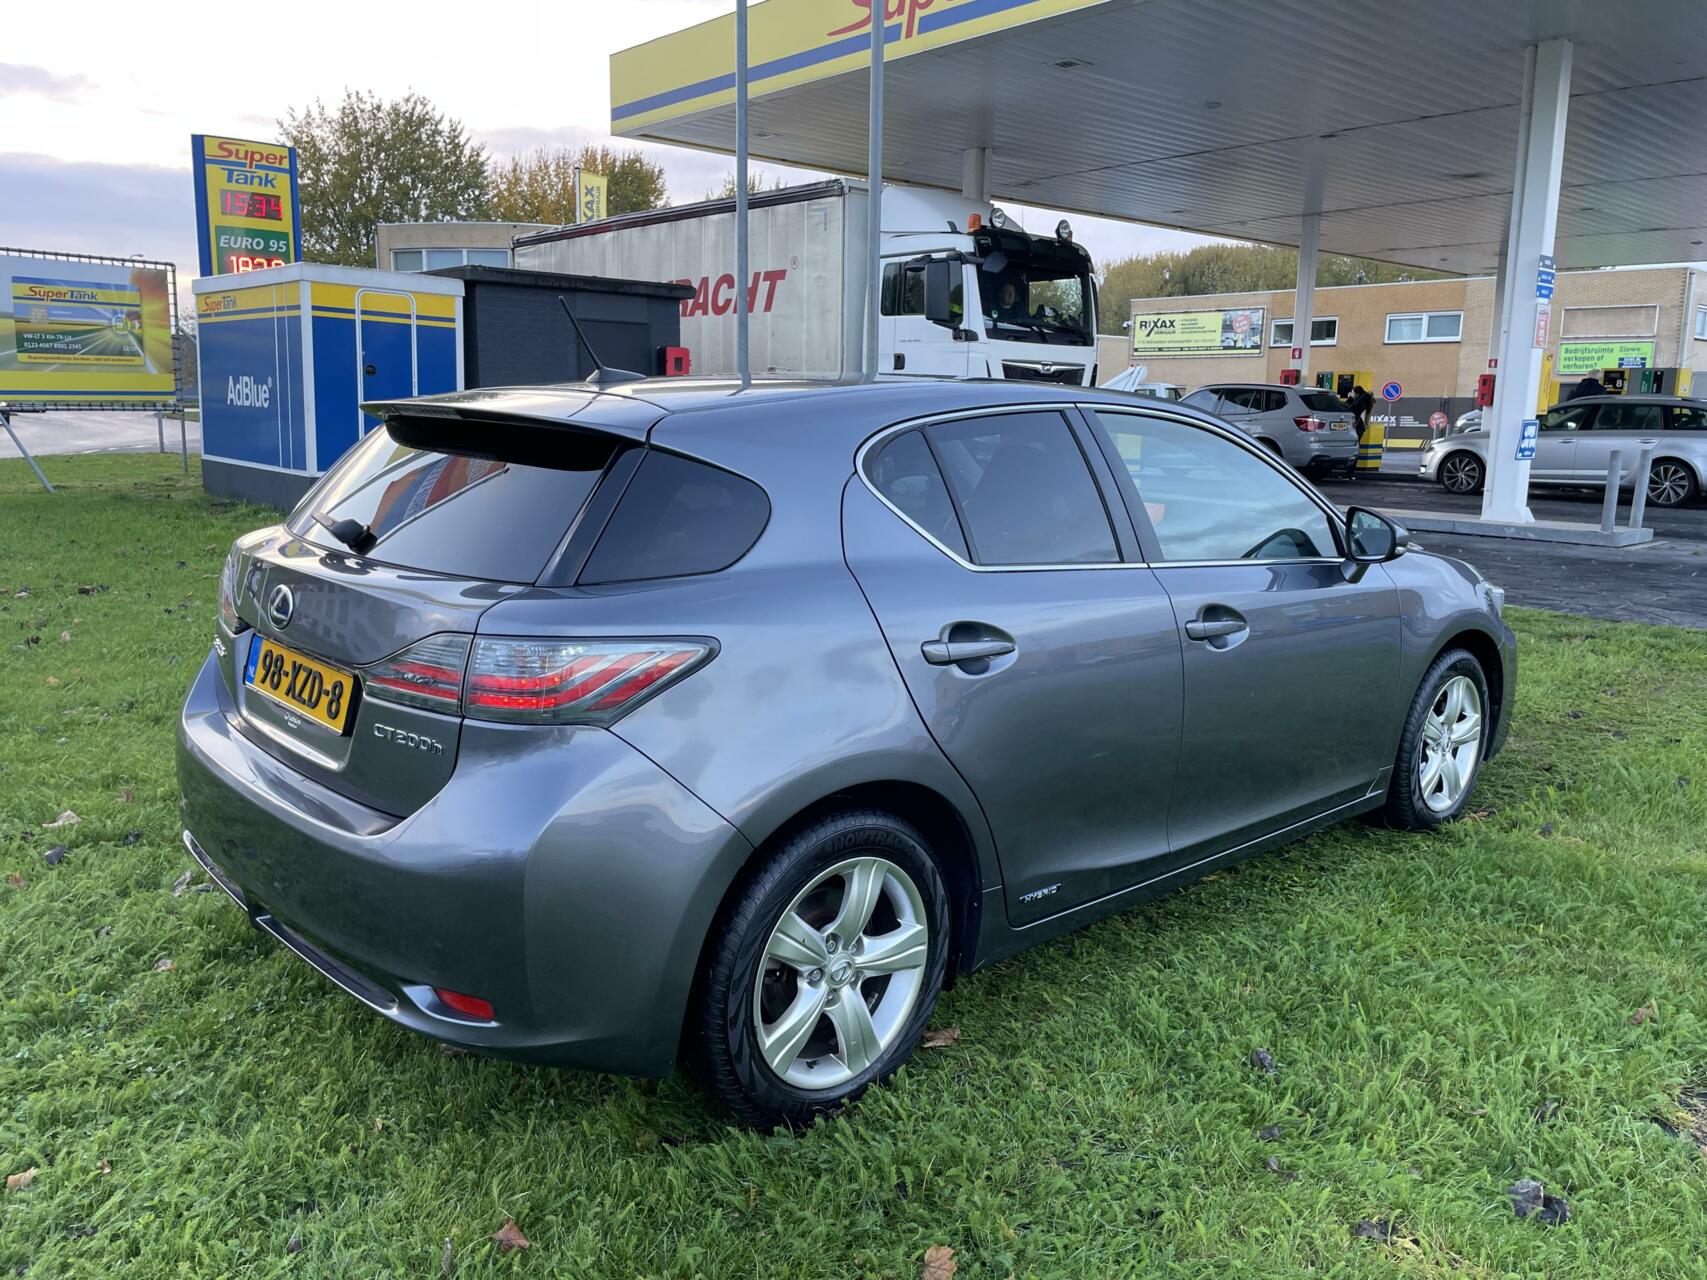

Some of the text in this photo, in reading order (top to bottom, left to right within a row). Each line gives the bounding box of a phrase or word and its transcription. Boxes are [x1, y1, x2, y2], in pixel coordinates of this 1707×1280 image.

[206, 141, 288, 169] Super
[220, 167, 277, 189] Tank
[224, 191, 283, 218] 15:34
[219, 234, 288, 252] EURO 95
[24, 285, 98, 303] SuperTank
[201, 295, 237, 317] SuperTank
[1139, 318, 1176, 337] RIXAX
[1564, 347, 1614, 355] Bedrijfsruimte
[1562, 362, 1598, 370] verhuren?
[1616, 379, 1622, 388] 8
[259, 648, 344, 720] 98-XZD-8
[372, 723, 445, 756] CT200h
